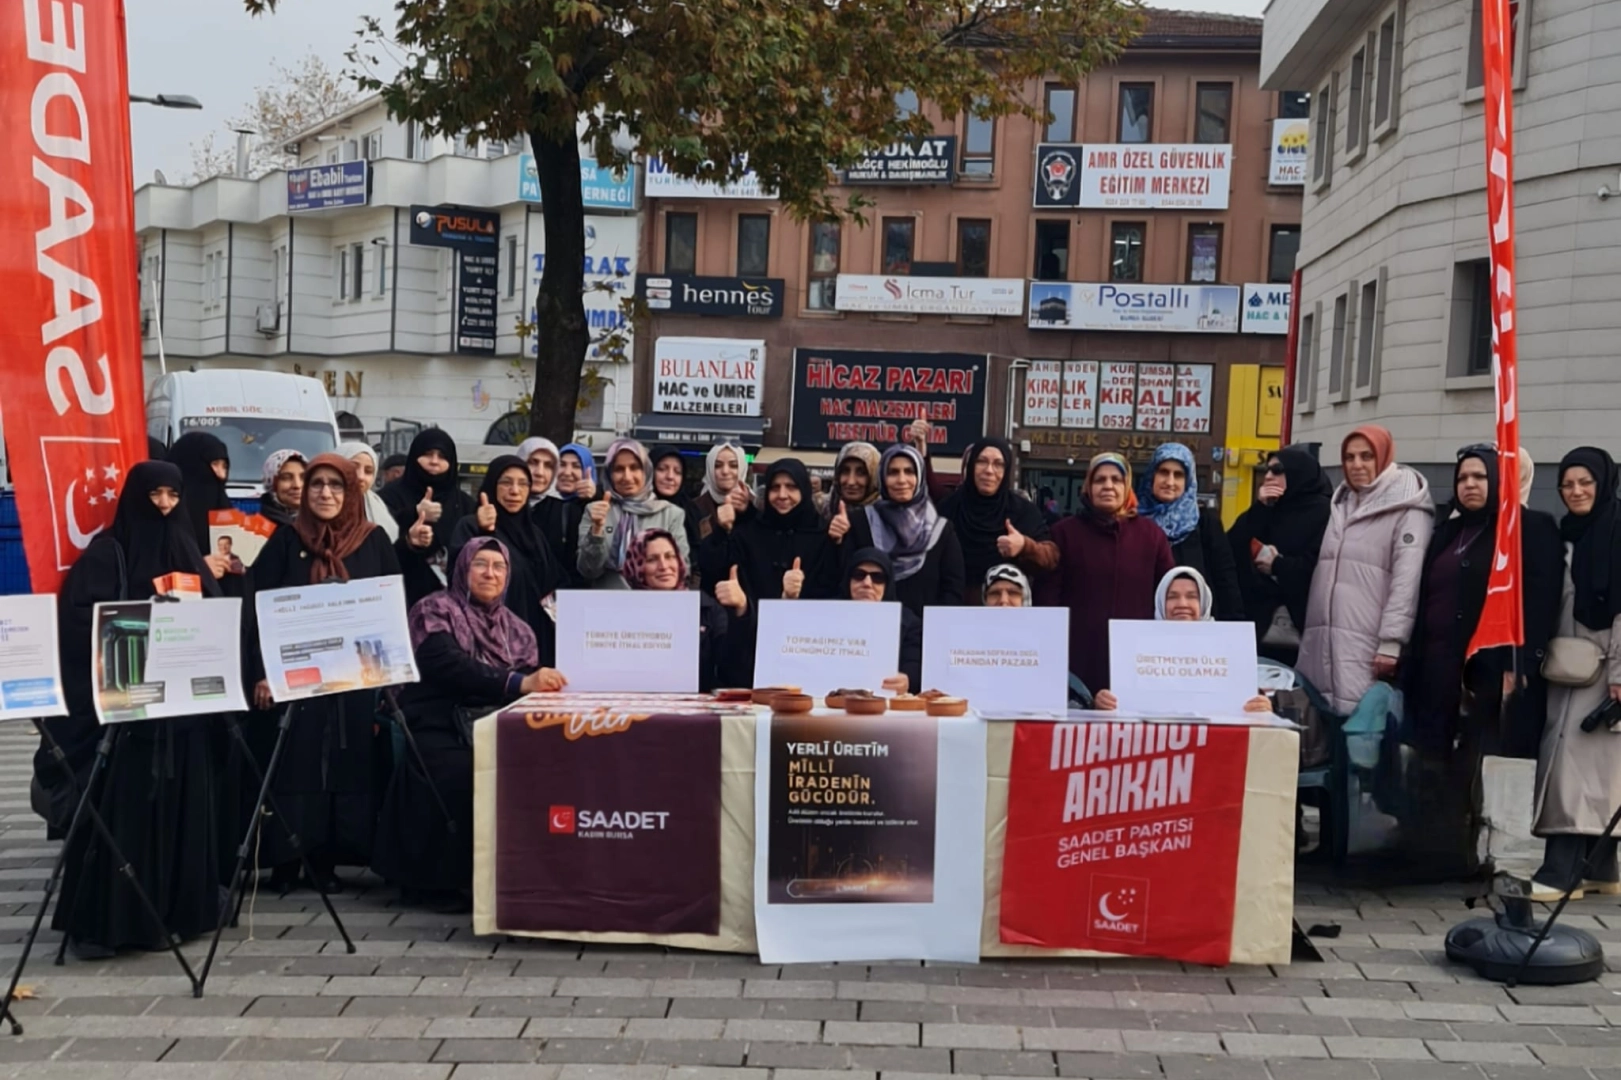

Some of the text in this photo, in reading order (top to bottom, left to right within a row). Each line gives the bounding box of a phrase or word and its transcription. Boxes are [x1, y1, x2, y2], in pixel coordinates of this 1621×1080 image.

[1088, 148, 1226, 169] AMR ÖZEL GÜVENLİK
[310, 166, 344, 188] Ebabil
[1279, 166, 1301, 175] HAC
[1100, 173, 1210, 196] EĞİTİM MERKEZİ
[436, 214, 495, 234] PUSULA
[683, 282, 774, 306] hennes
[950, 285, 976, 300] Tur
[660, 359, 756, 380] BULANLAR
[806, 358, 974, 394] HİCAZ PAZARI
[658, 382, 756, 400] HAC ve UMRE
[663, 400, 747, 415] MALZEMELERİ
[820, 398, 852, 416] HAC
[1102, 415, 1208, 431] 0532 421 02 47
[848, 638, 867, 647] VAR
[1000, 658, 1039, 668] PAZARA
[1200, 655, 1228, 666] ÜLKE
[1136, 664, 1228, 679] GÜÇLÜ OLAMAZ
[787, 740, 889, 758] YERLİ ÜRETİM
[789, 758, 834, 774] MİLLİ
[789, 774, 871, 791] İRADENİN
[1063, 752, 1195, 823] ARIKAN
[577, 810, 670, 830] SAADET
[1057, 828, 1125, 854] SAADET
[1056, 834, 1193, 869] GENEL BAŞKANI
[1093, 918, 1140, 934] SAADET
